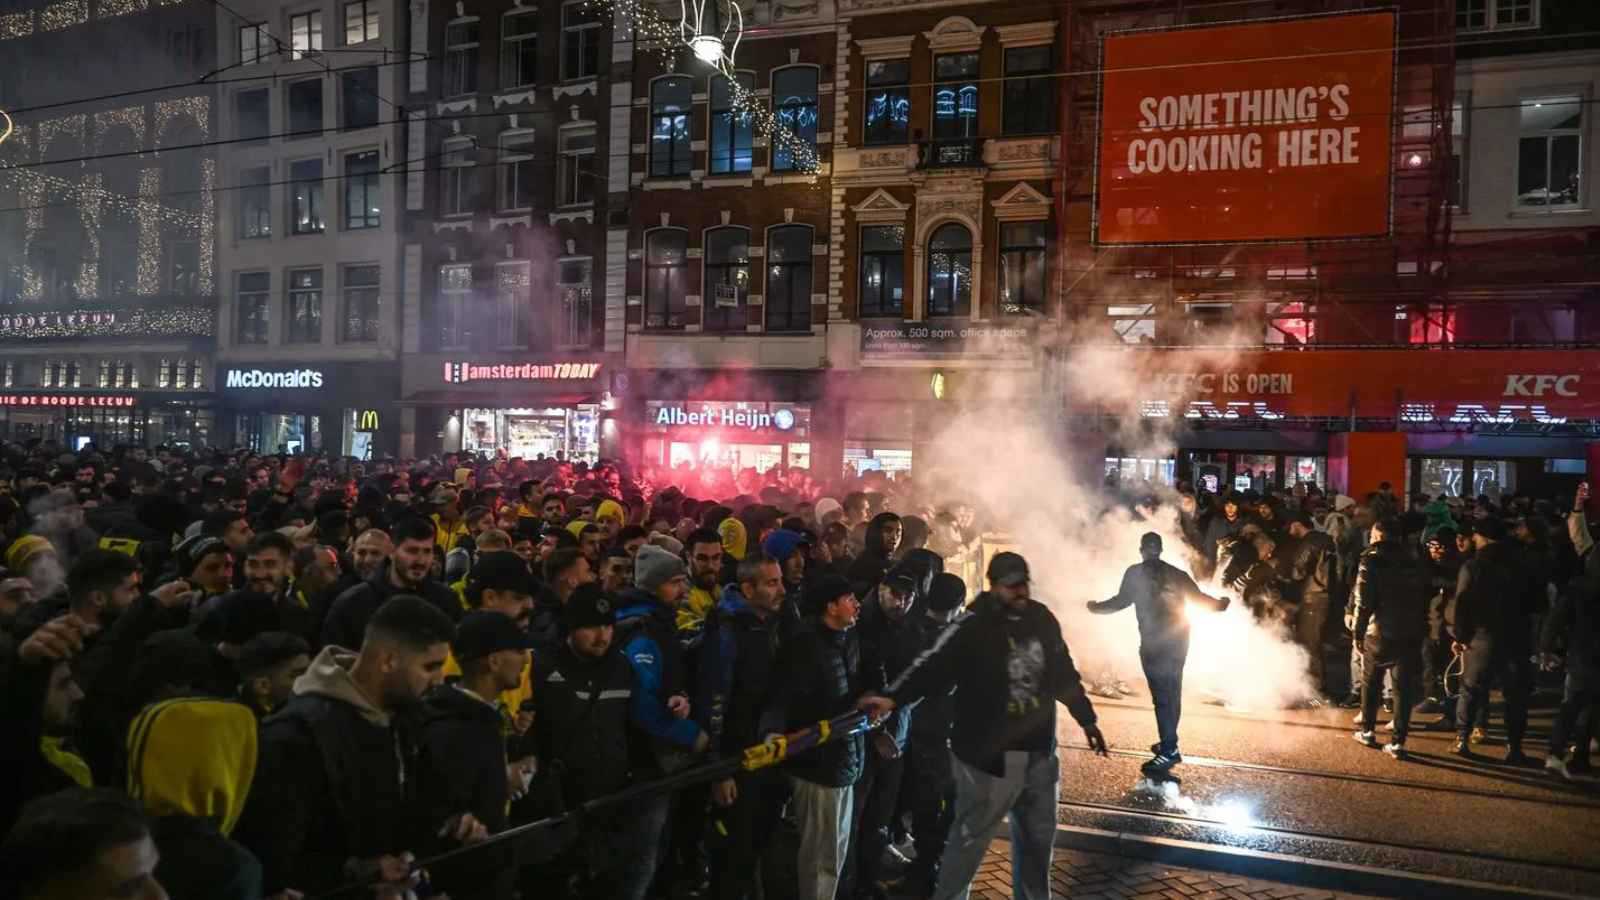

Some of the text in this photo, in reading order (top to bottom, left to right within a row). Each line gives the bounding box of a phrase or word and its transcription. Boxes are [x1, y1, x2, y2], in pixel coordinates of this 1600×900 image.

[1138, 84, 1349, 132] SOMETHING'S
[1127, 127, 1360, 174] COOKING HERE
[865, 328, 906, 340] Approx.
[909, 328, 928, 338] 500
[226, 368, 323, 388] McDonald's
[1222, 373, 1239, 393] IS
[1246, 373, 1293, 394] OPEN
[1503, 374, 1580, 396] KFC
[0, 395, 17, 405] IE
[91, 396, 134, 406] LEEUW
[657, 407, 714, 425] Albert
[720, 408, 771, 430] Heijn
